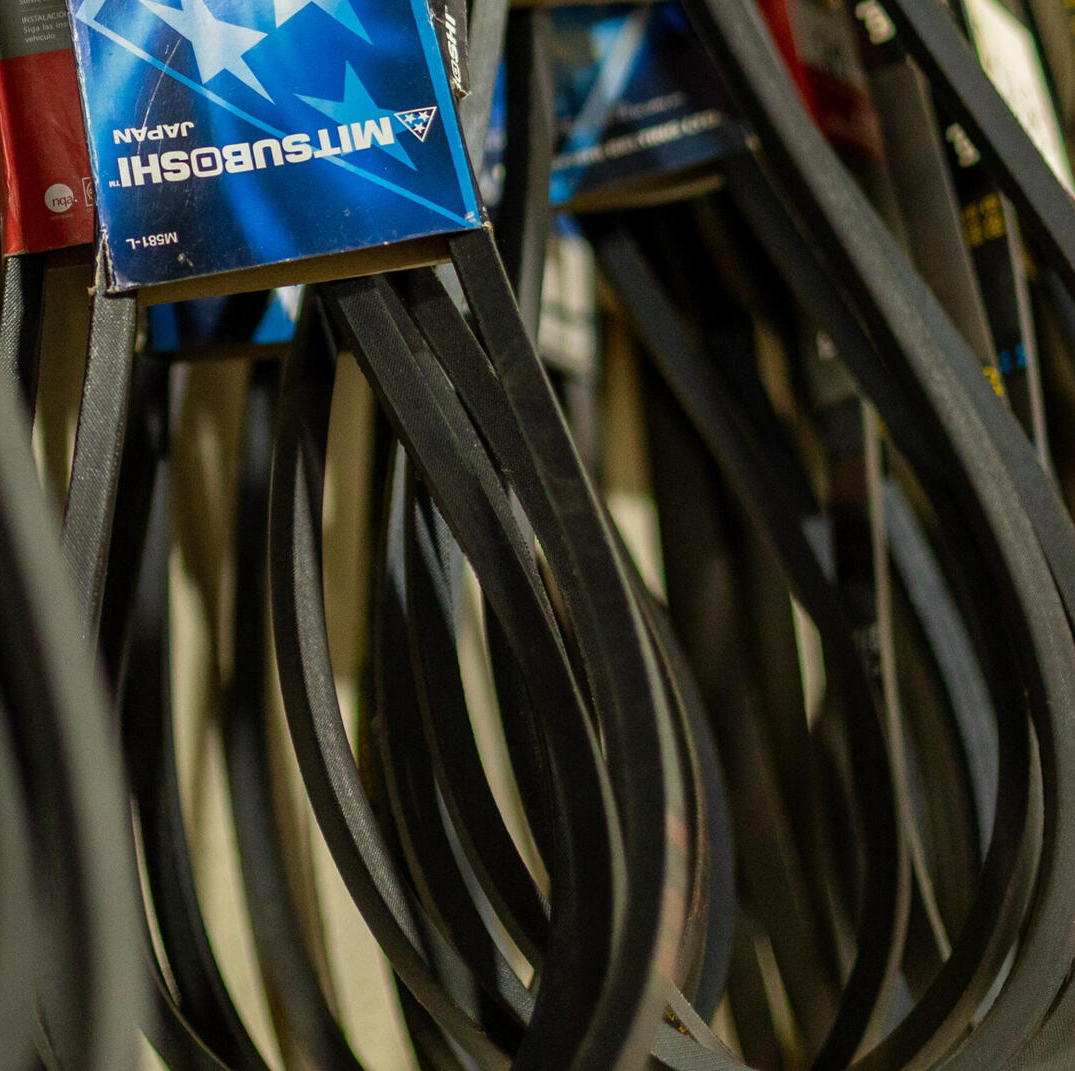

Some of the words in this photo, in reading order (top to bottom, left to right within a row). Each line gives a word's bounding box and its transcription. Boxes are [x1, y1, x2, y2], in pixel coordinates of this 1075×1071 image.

[21, 11, 67, 24] INSTALACIÓ
[23, 25, 40, 34] Siga
[112, 120, 195, 145] JAPAN
[117, 116, 395, 188] MITSUBOSHI
[125, 231, 179, 250] M581-L
